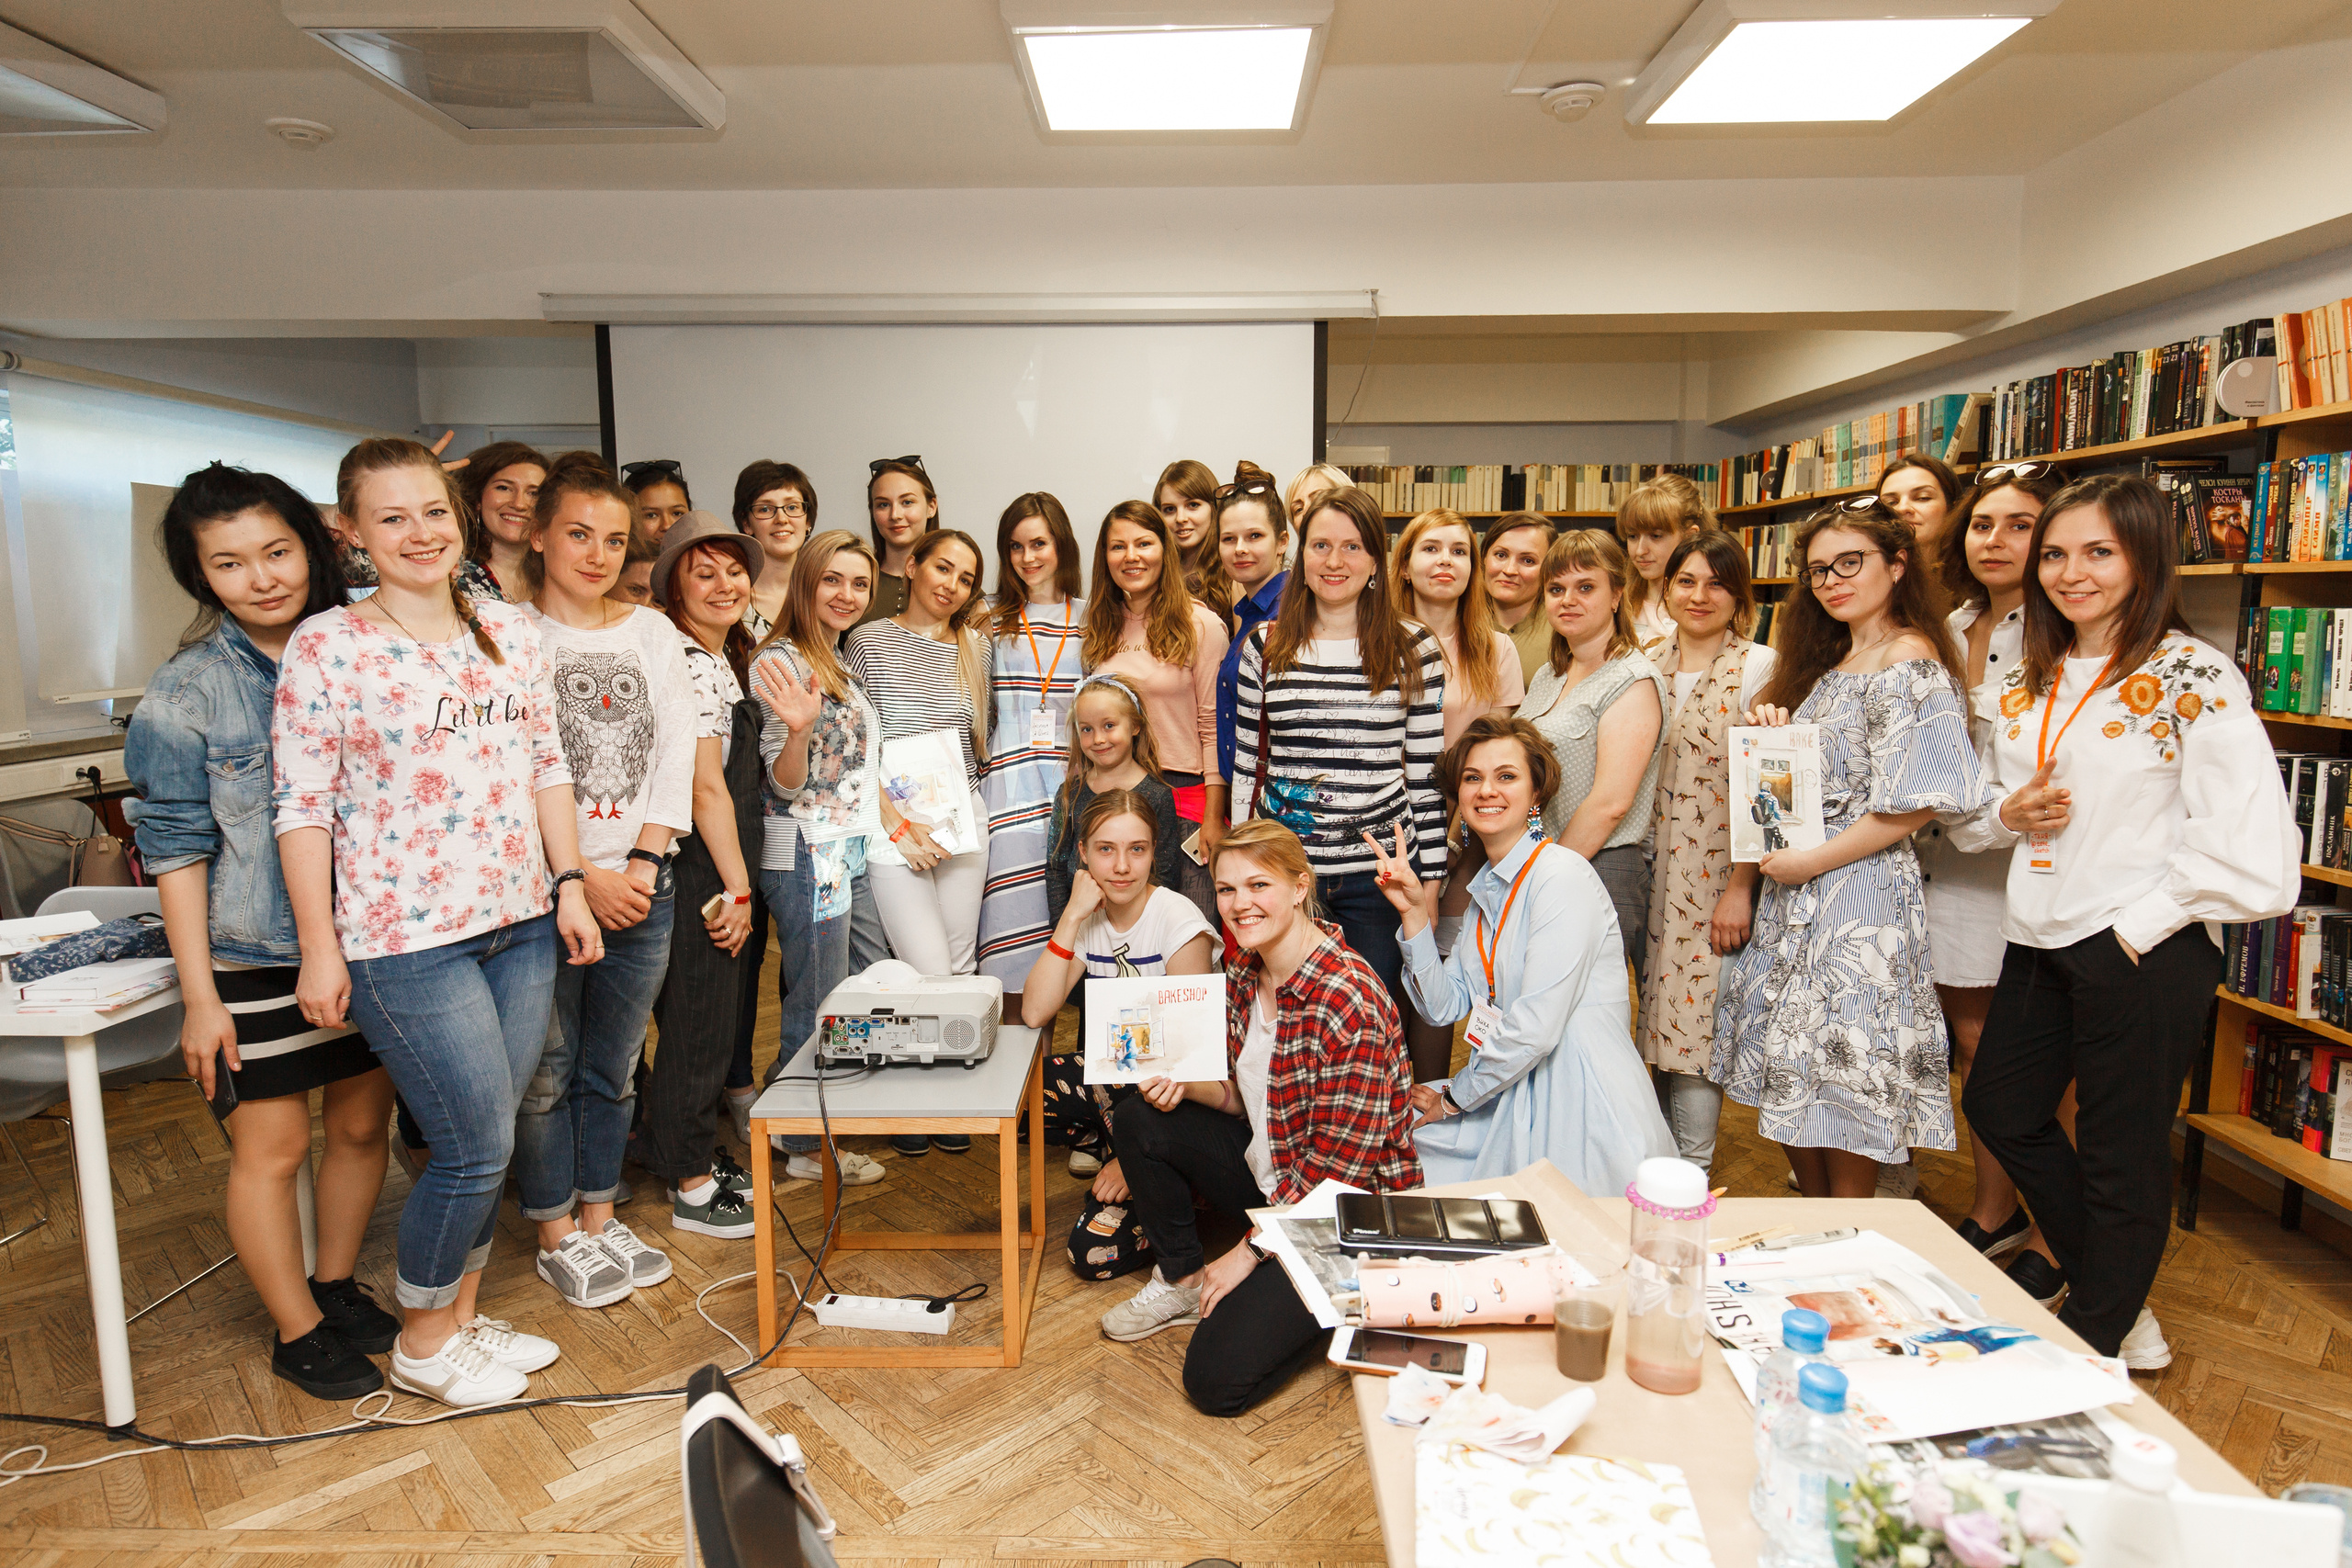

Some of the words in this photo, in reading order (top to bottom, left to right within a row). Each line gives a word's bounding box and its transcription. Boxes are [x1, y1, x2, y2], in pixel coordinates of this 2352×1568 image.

[2170, 354, 2178, 362] 23
[2199, 479, 2216, 487] ЧЕЛСИ
[2213, 488, 2243, 496] КОСТРЫ
[2211, 495, 2247, 503] ТОСКАНЫ
[2302, 496, 2312, 547] СЛИМПЕР
[2312, 512, 2321, 548] СЛИМП
[420, 696, 469, 741] Let
[477, 698, 498, 727] it
[504, 694, 529, 723] be
[2325, 815, 2335, 858] ПОСЛАННИК
[2240, 945, 2249, 983] ЕФРЕМОВ
[1158, 987, 1207, 1005] BAKESHOP
